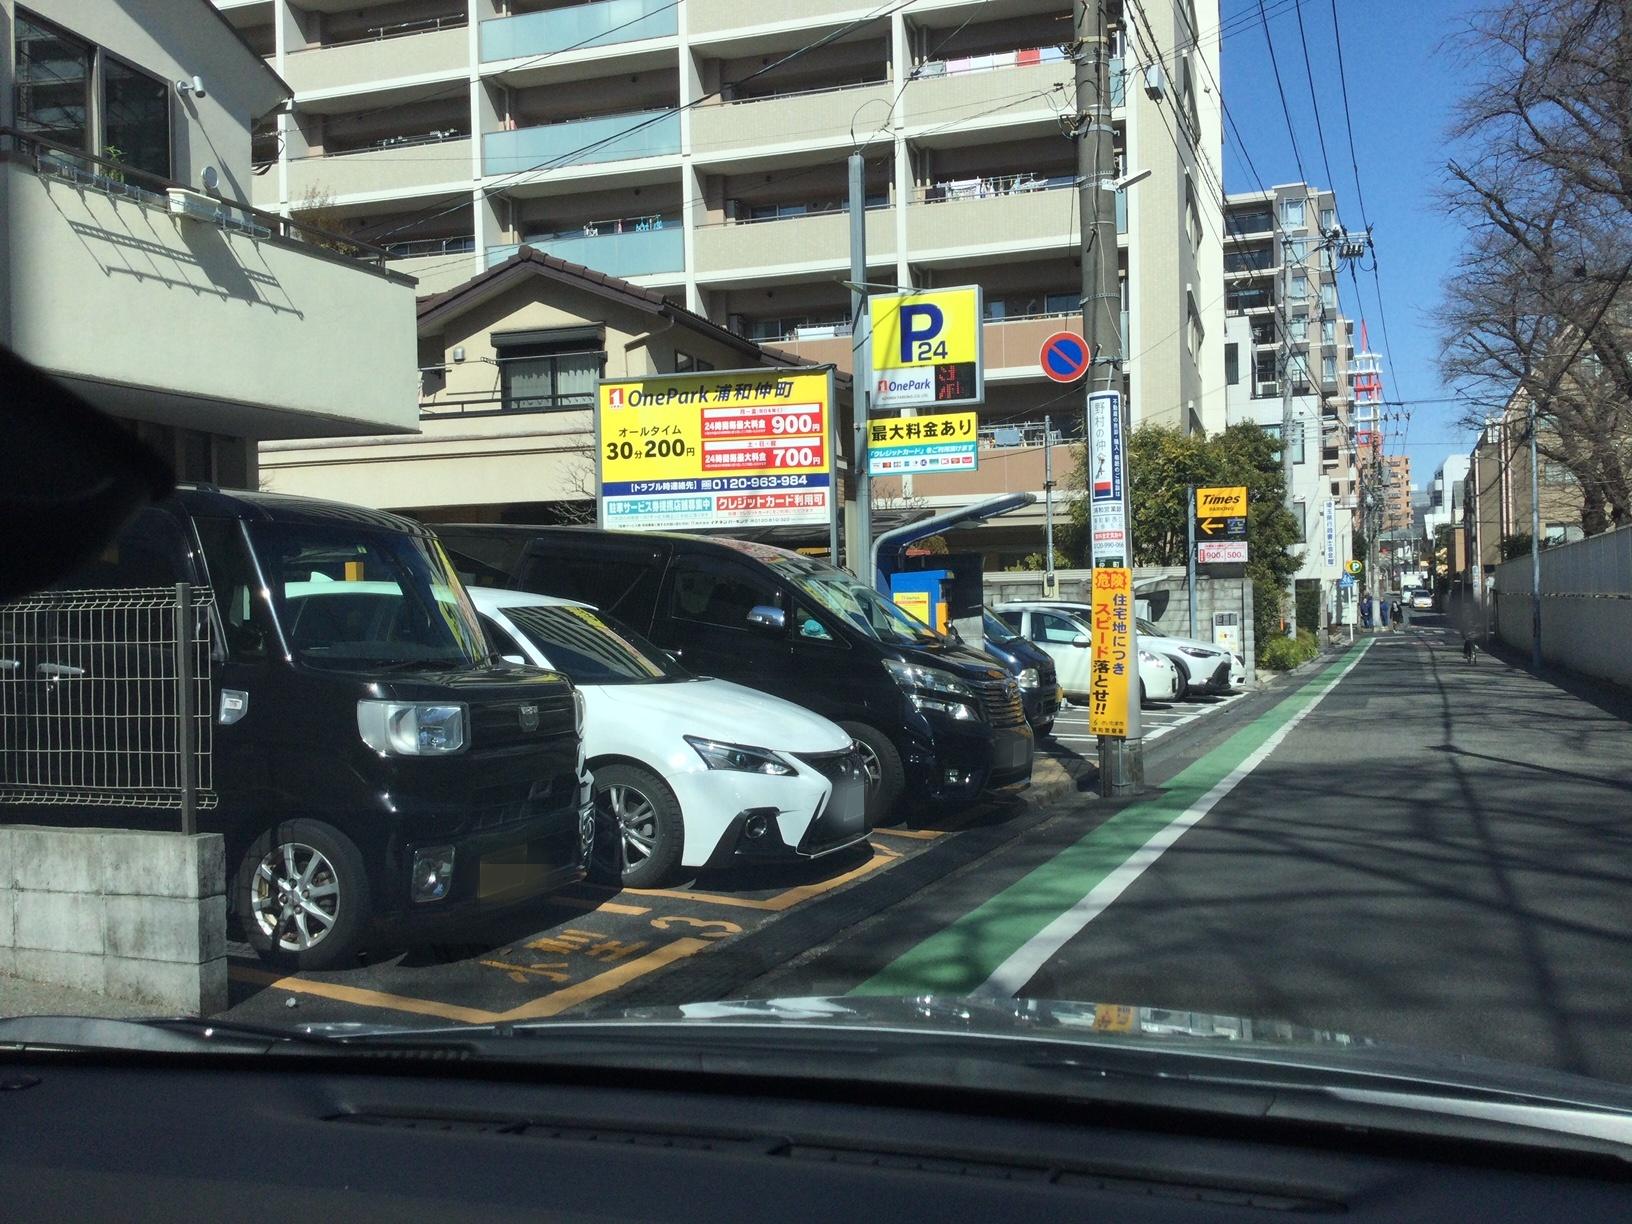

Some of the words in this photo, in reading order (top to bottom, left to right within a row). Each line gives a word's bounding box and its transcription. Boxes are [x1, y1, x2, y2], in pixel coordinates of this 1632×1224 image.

[899, 303, 944, 363] P
[917, 340, 948, 361] 24
[627, 385, 709, 407] OnePark
[713, 381, 794, 402] 浦和仲町
[888, 379, 931, 392] OnePark
[618, 425, 682, 438] オールタイム
[771, 414, 820, 434] 900円
[872, 419, 972, 442] 最大料金あり
[606, 438, 695, 461] 30分200円
[772, 447, 821, 467] 700円
[712, 475, 808, 490] 0120-963-984
[718, 493, 824, 509] クレジットカード利用可
[1202, 494, 1241, 506] Times
[1226, 517, 1246, 535] 空
[1096, 573, 1127, 588] 危険
[1112, 593, 1128, 676] 住宅地につき
[1092, 603, 1112, 715] スピード落とせ!!
